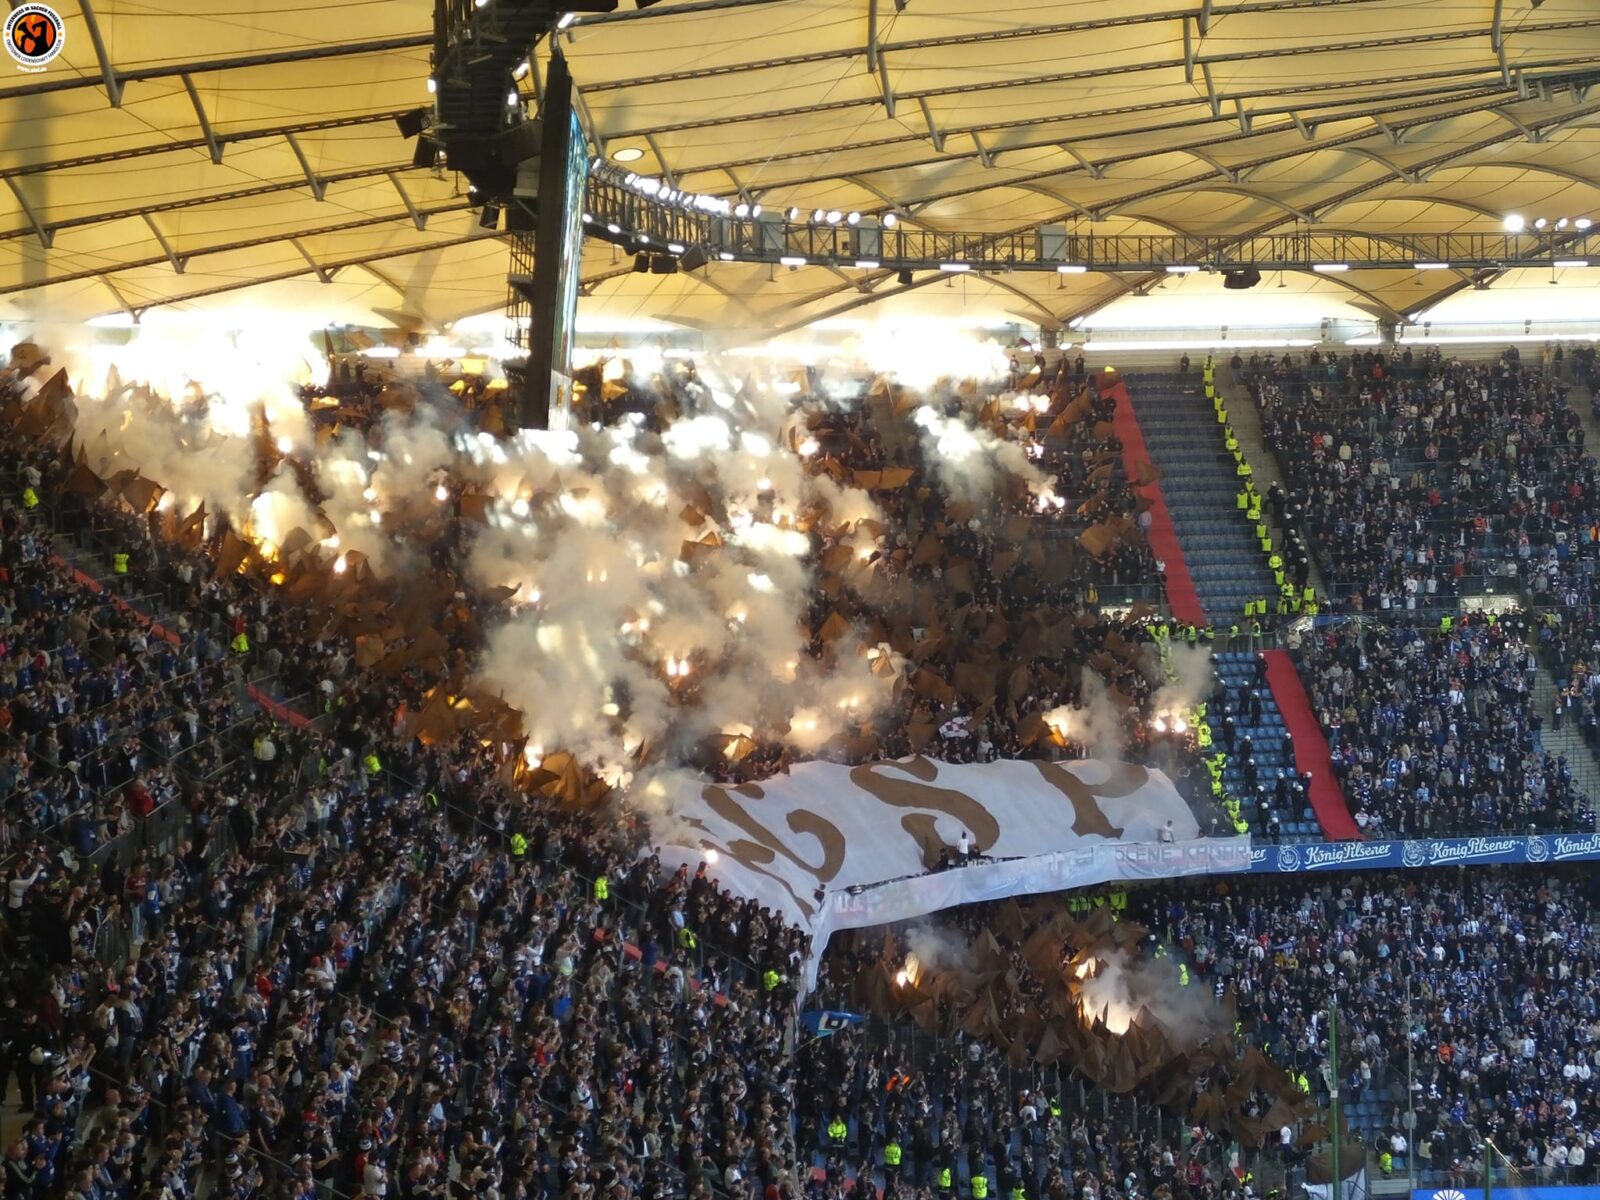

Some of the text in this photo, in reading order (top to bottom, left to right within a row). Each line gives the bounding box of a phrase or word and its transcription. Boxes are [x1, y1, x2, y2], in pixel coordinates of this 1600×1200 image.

[1304, 842, 1392, 864] König Pilsener
[1429, 837, 1516, 860] König Pilsener
